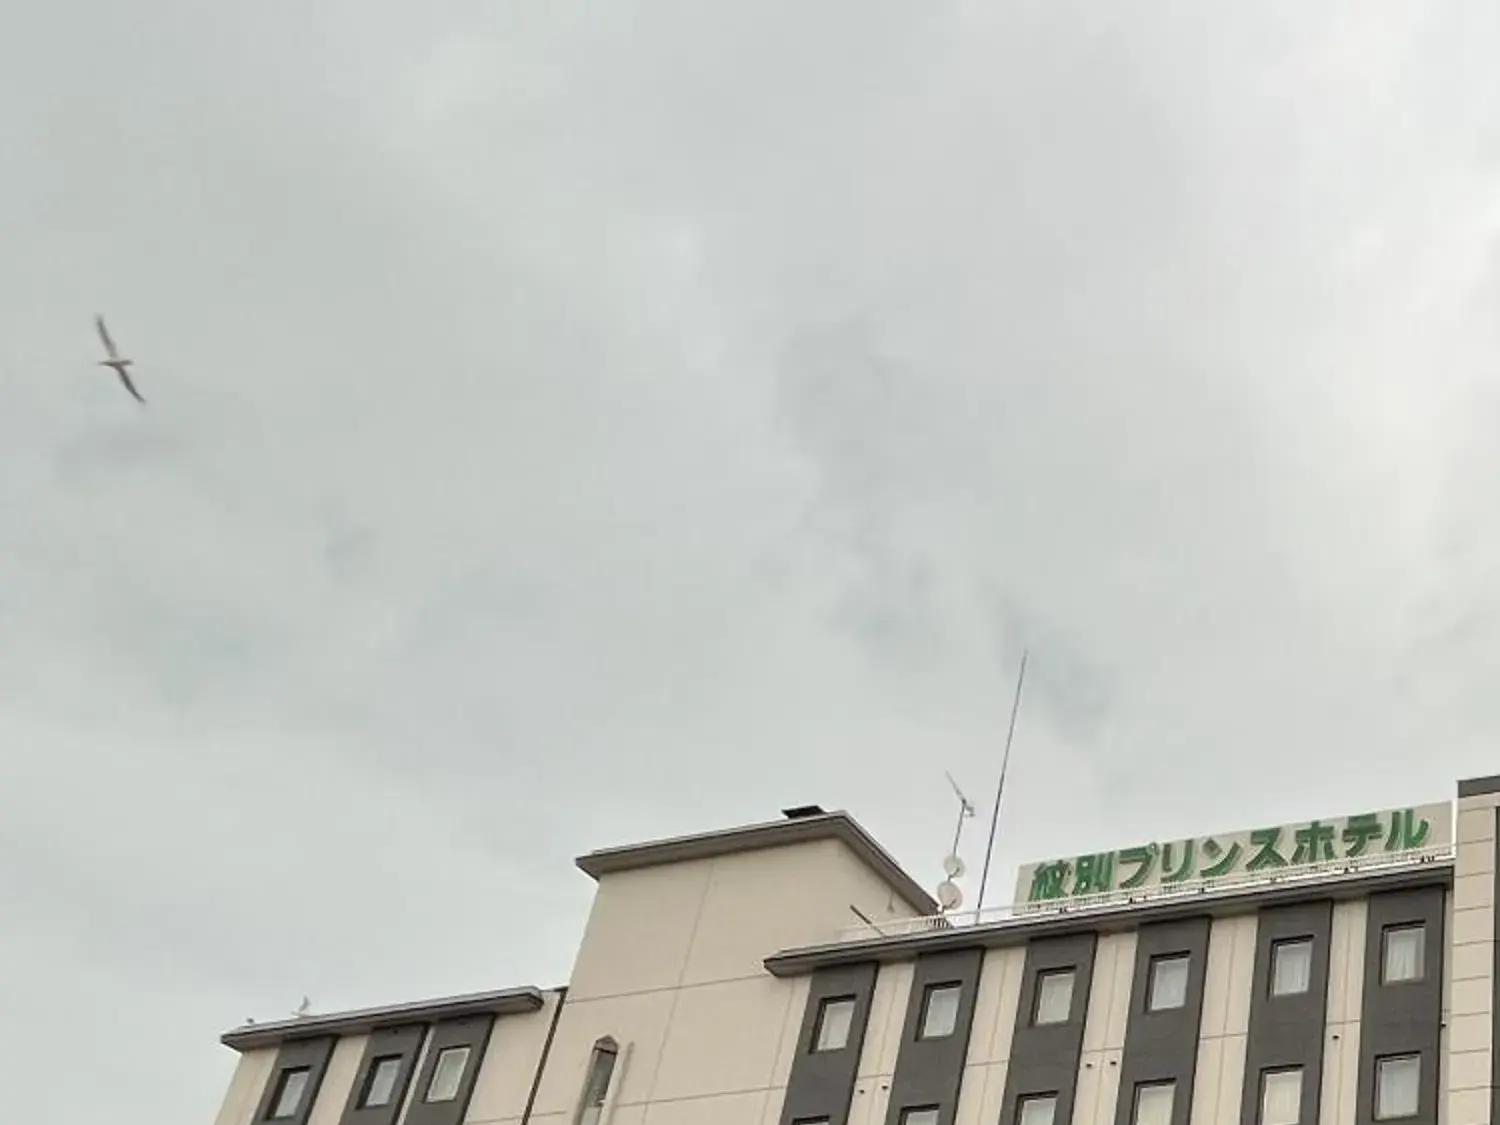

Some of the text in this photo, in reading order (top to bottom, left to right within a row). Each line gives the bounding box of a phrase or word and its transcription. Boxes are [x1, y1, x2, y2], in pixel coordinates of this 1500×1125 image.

[1028, 809, 1431, 902] 紋別プリンスホテル
